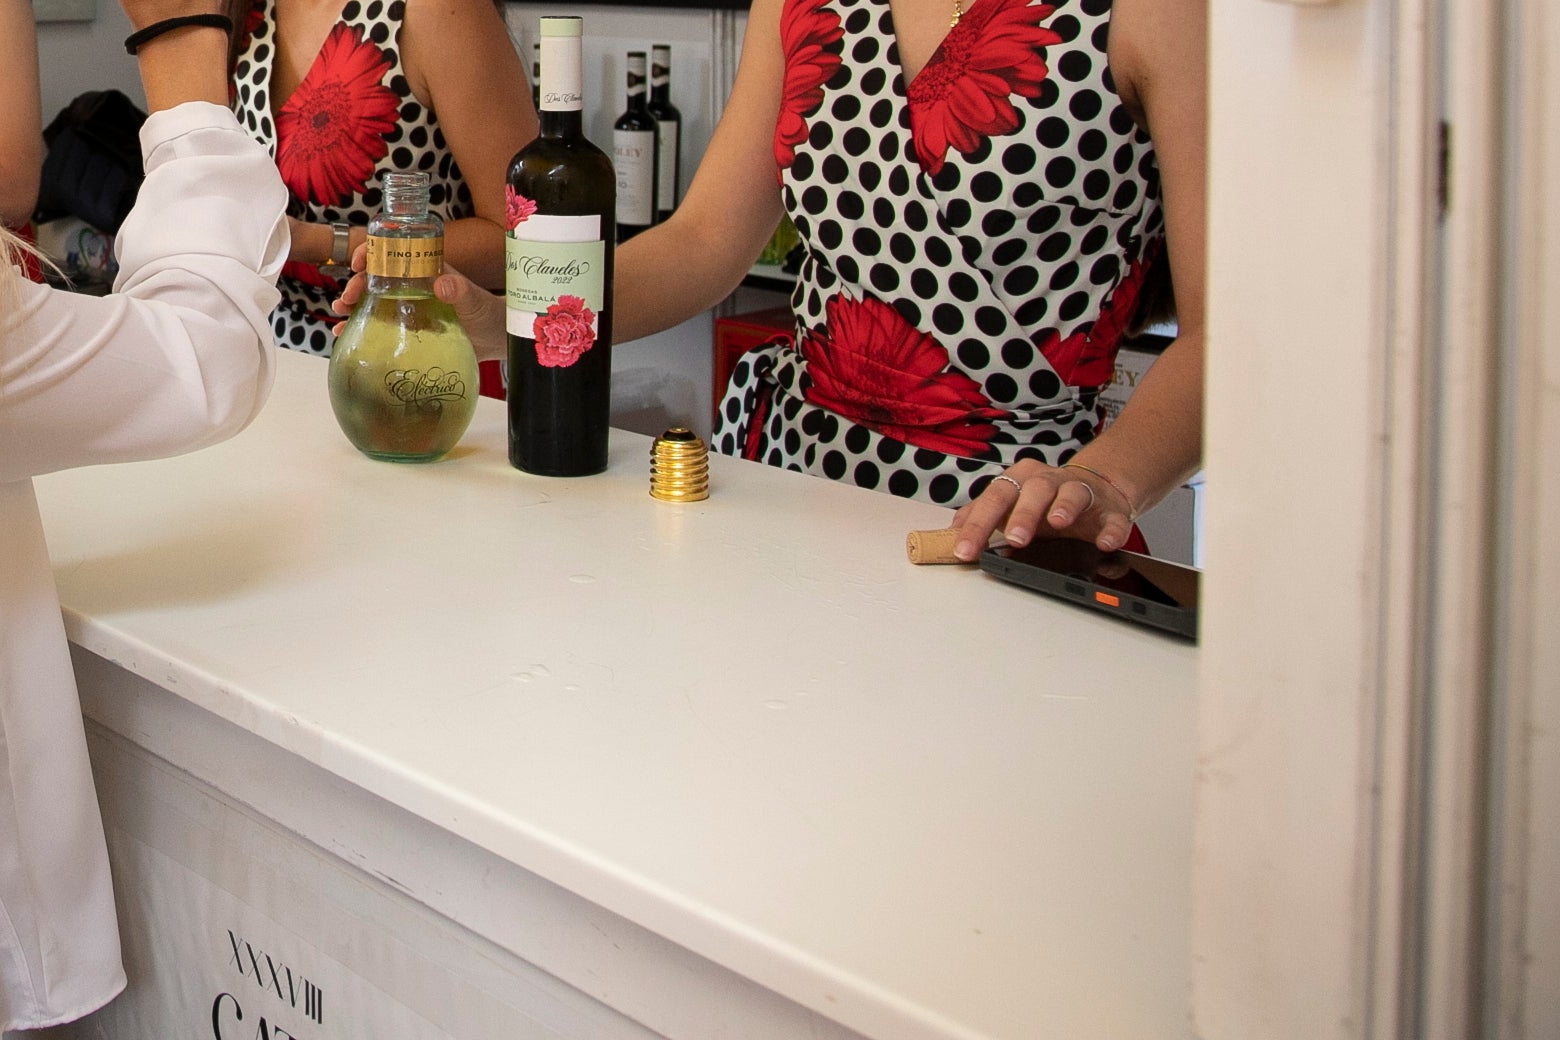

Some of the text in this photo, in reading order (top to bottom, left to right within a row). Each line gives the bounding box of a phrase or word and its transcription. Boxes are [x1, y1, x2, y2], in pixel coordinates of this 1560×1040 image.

[387, 250, 412, 258] FINO
[519, 255, 590, 280] Claveles
[227, 928, 324, 1025] XXXVIII
